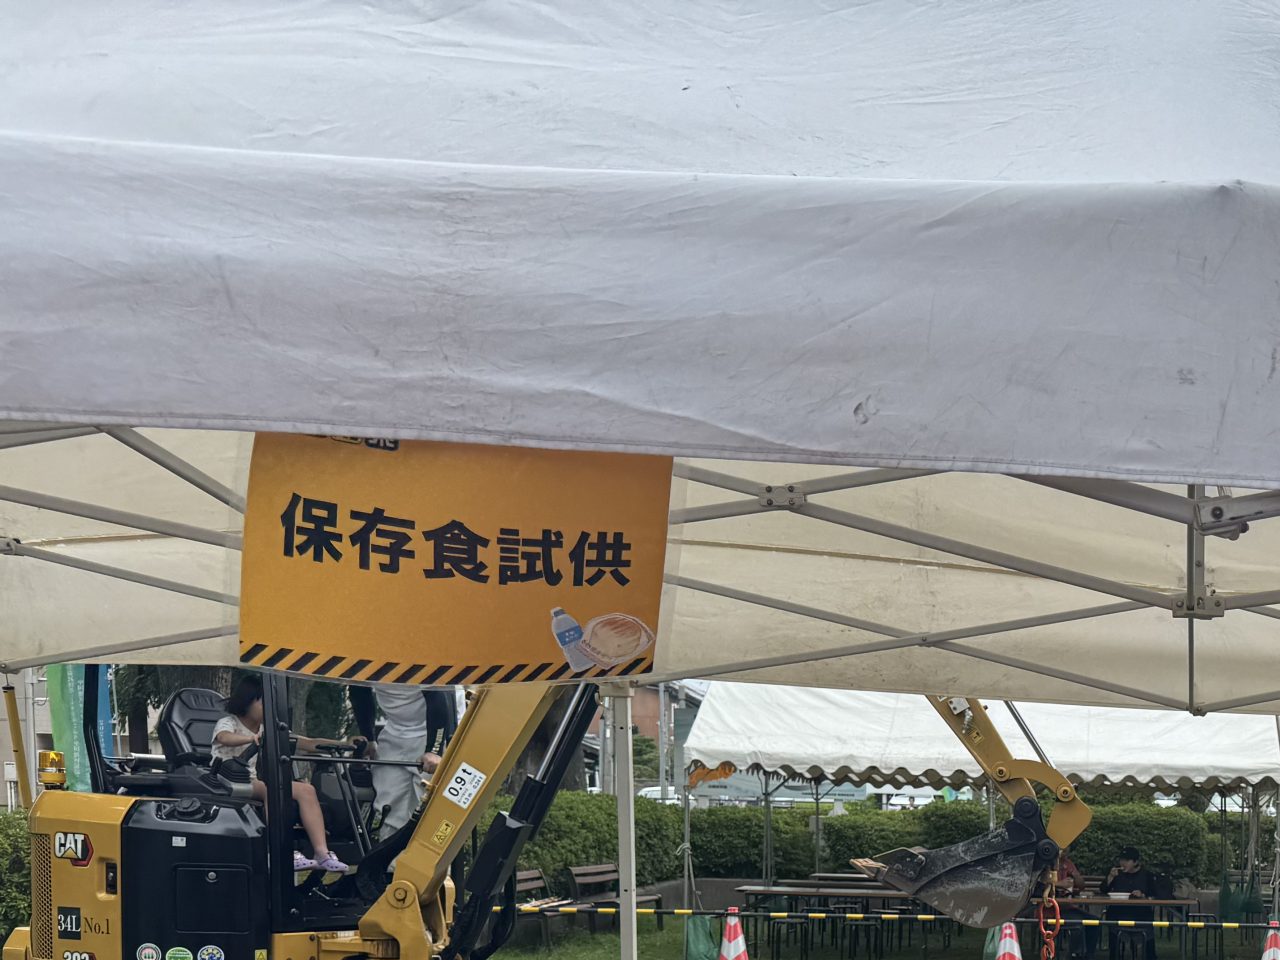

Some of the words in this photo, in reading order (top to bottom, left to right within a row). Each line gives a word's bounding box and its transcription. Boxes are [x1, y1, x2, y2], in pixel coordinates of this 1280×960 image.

[280, 491, 633, 588] 保存食試供
[448, 776, 466, 797] 0.9
[462, 768, 472, 776] t
[55, 832, 85, 859] CAT
[58, 914, 81, 932] 34L
[84, 917, 111, 935] No.1
